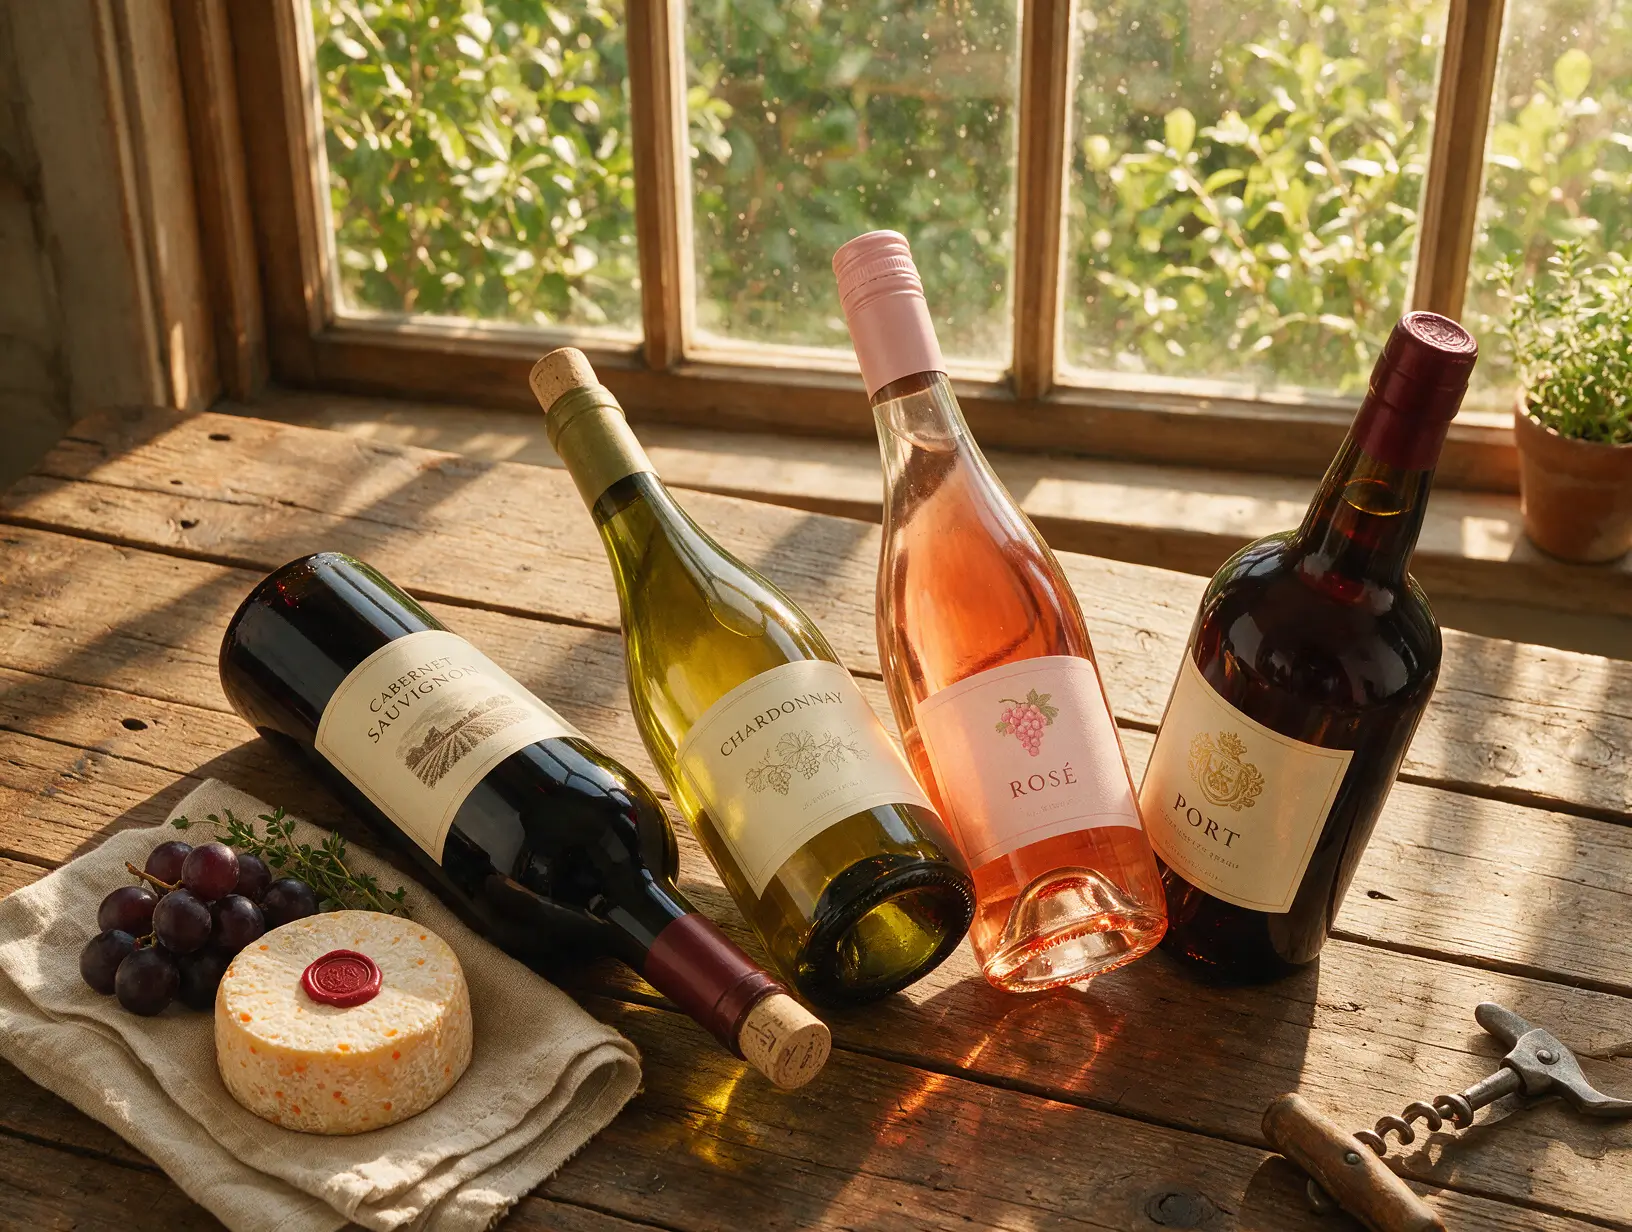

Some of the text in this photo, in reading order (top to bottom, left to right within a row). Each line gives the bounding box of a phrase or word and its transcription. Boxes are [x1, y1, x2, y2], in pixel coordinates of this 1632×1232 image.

[367, 665, 479, 743] SAUVIGNON
[369, 656, 452, 712] CABERNET
[720, 691, 842, 757] CHARDONNAY
[1009, 762, 1077, 799] ROSÉ
[1173, 792, 1240, 848] PORT
